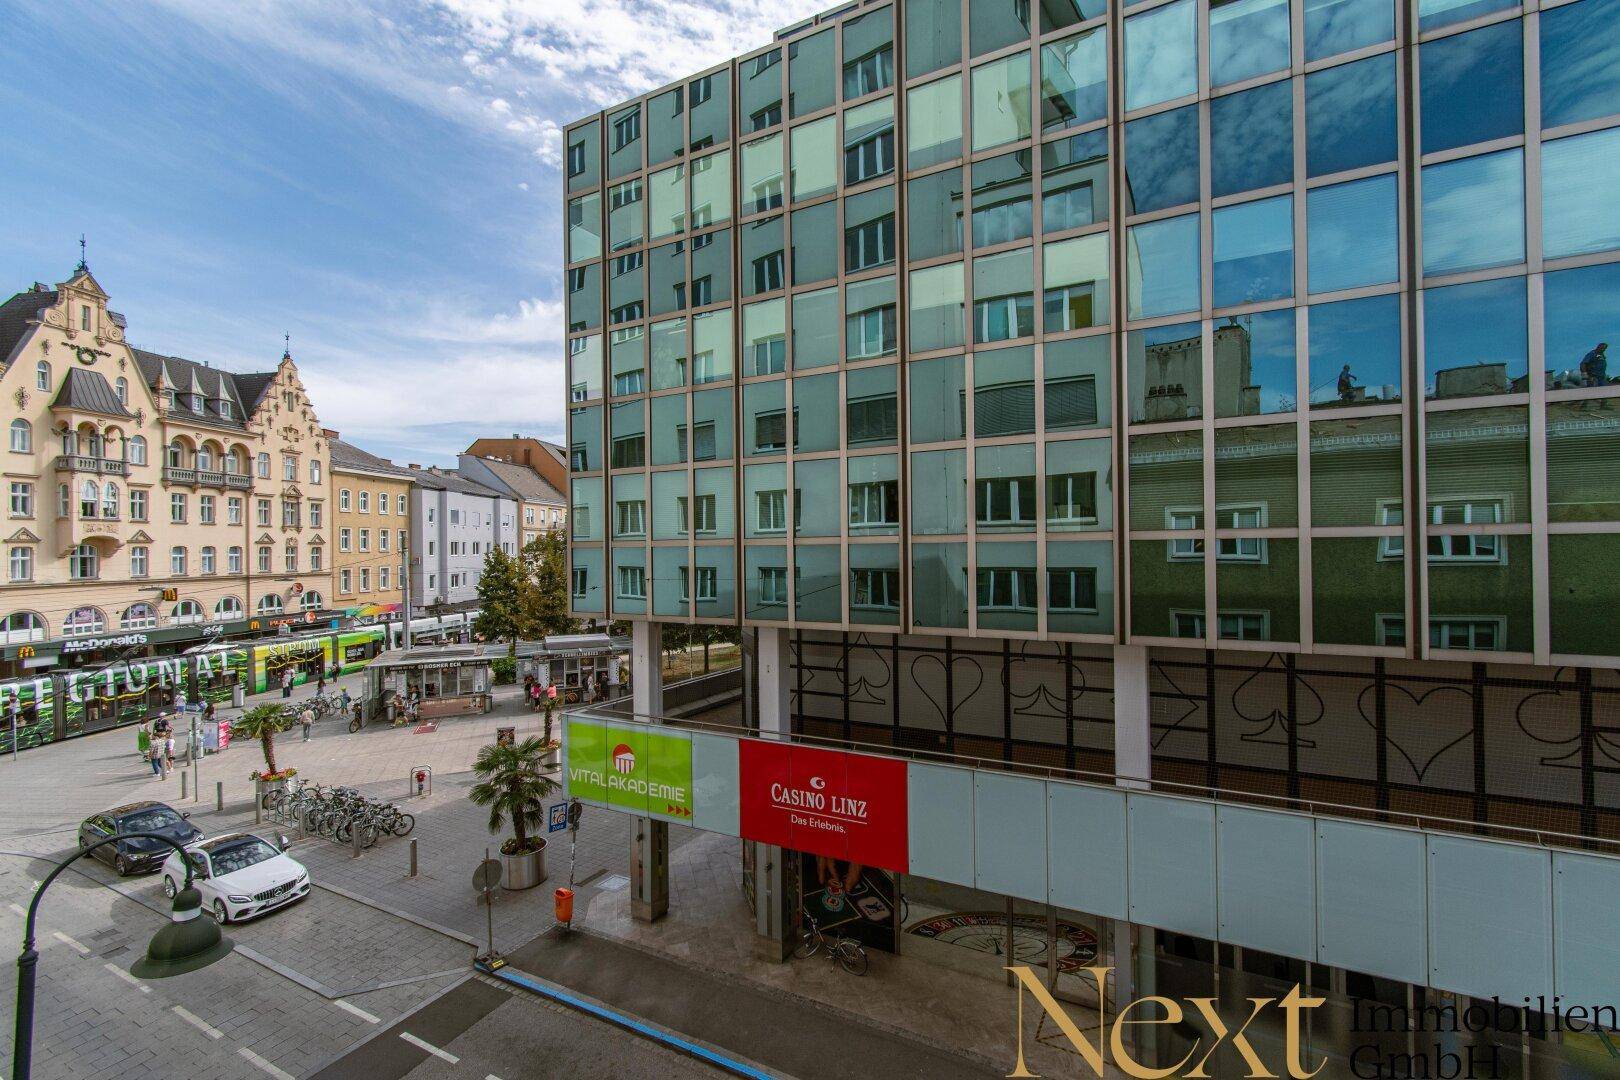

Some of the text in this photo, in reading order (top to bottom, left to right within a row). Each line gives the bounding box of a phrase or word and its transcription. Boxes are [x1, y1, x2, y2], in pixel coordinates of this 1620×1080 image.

[64, 634, 148, 653] McDonald's
[569, 767, 685, 803] VITALAKADEMIE
[771, 782, 867, 818] CASINO LINZ
[791, 814, 847, 834] Das Erlebnis.
